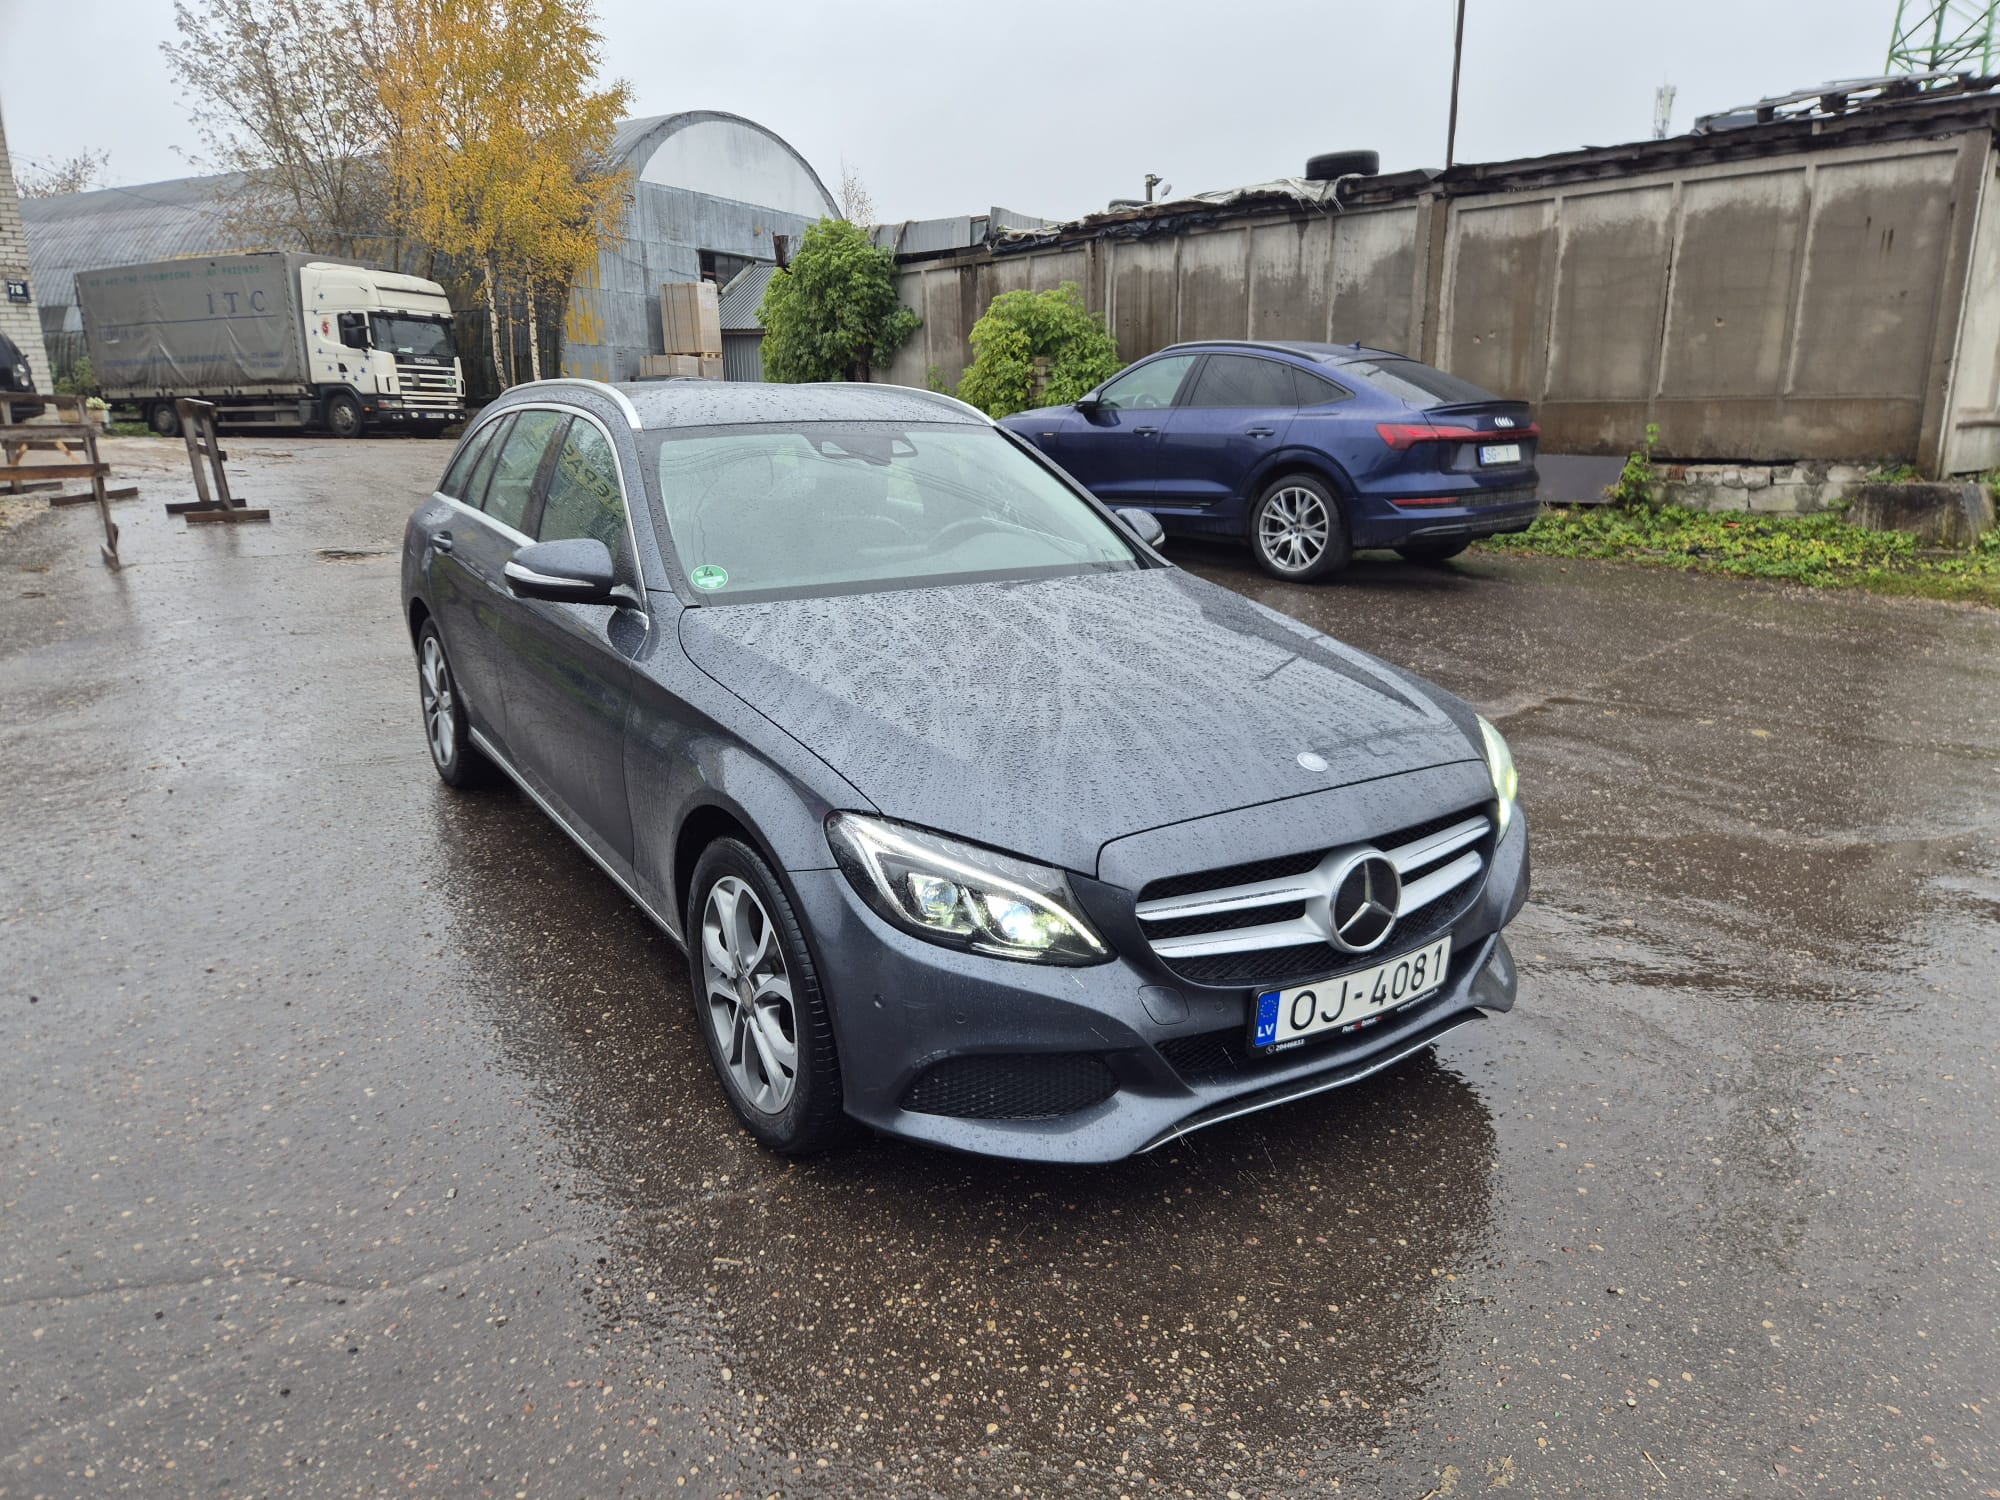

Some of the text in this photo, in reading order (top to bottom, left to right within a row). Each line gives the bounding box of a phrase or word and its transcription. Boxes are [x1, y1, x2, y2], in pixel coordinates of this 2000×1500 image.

[703, 566, 714, 577] 4
[1290, 943, 1443, 1031] OJ-4081
[1257, 1023, 1274, 1038] LV
